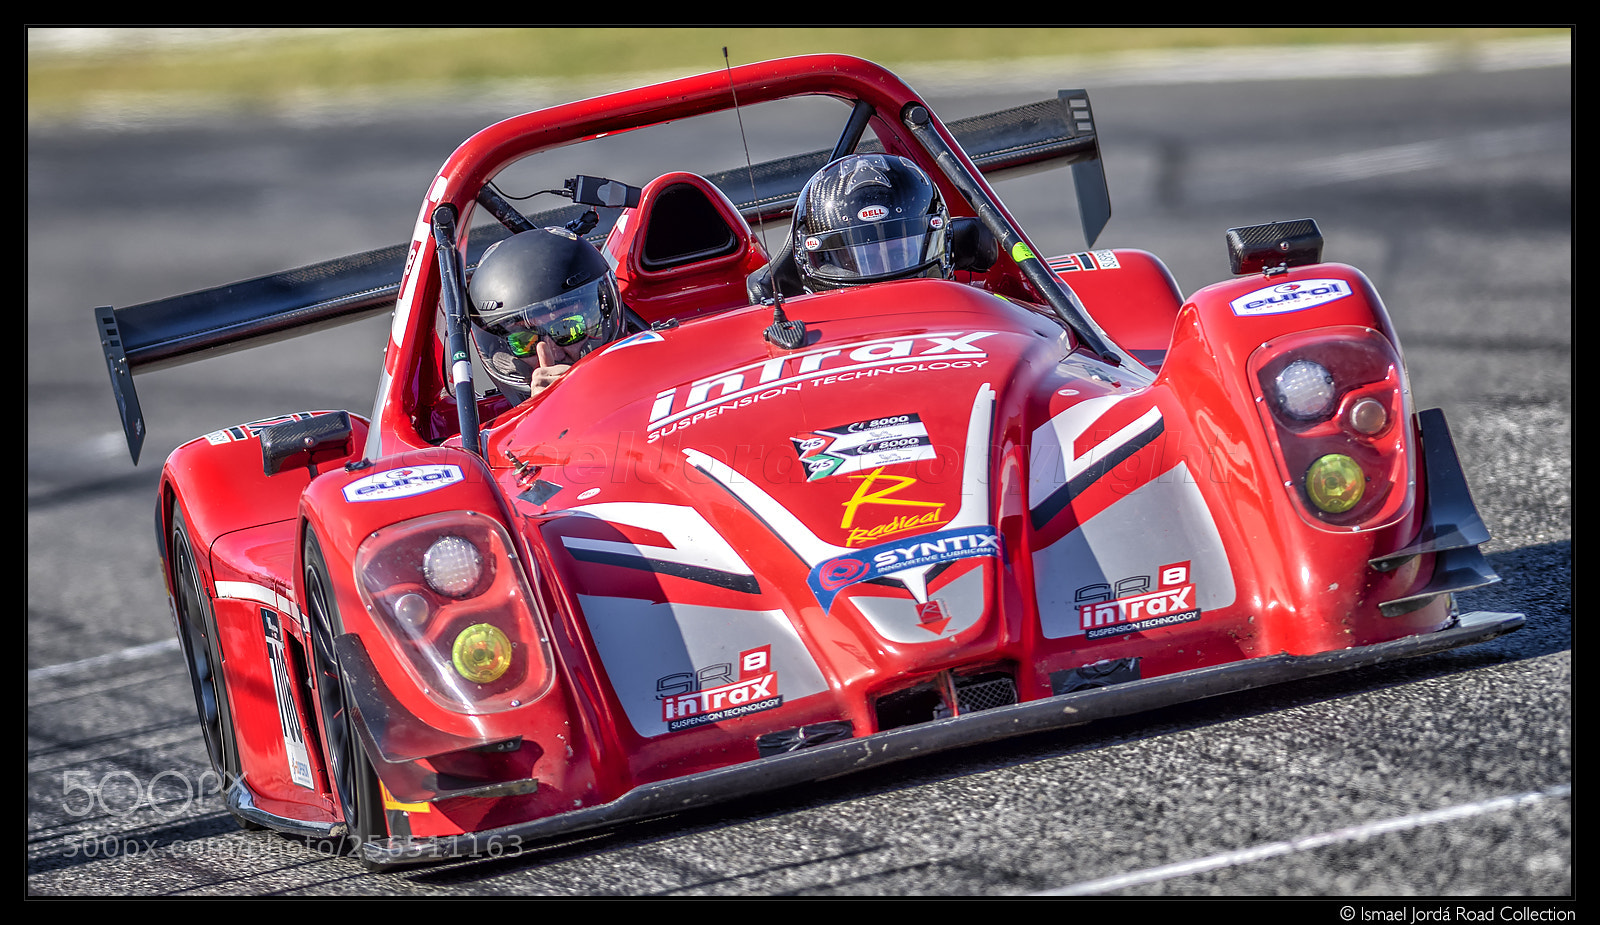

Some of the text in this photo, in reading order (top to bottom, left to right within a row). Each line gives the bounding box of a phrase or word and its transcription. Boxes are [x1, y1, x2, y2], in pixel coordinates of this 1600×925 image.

[862, 208, 885, 218] BELL
[806, 238, 818, 247] BELL
[1244, 283, 1342, 310] eurol
[647, 360, 989, 444] SUSPENSION TECHNOLOGY
[869, 415, 909, 427] 8000
[879, 437, 919, 449] 8000
[356, 469, 454, 495] eurol
[840, 466, 946, 528] R
[845, 508, 943, 547] Radical
[873, 533, 1000, 568] SYNTIX
[877, 553, 938, 574] INNOVATIVE
[1088, 611, 1198, 638] SUSPENSION TECHNOLOGY
[671, 697, 780, 729] SUSPENSION TECHNOLOGY
